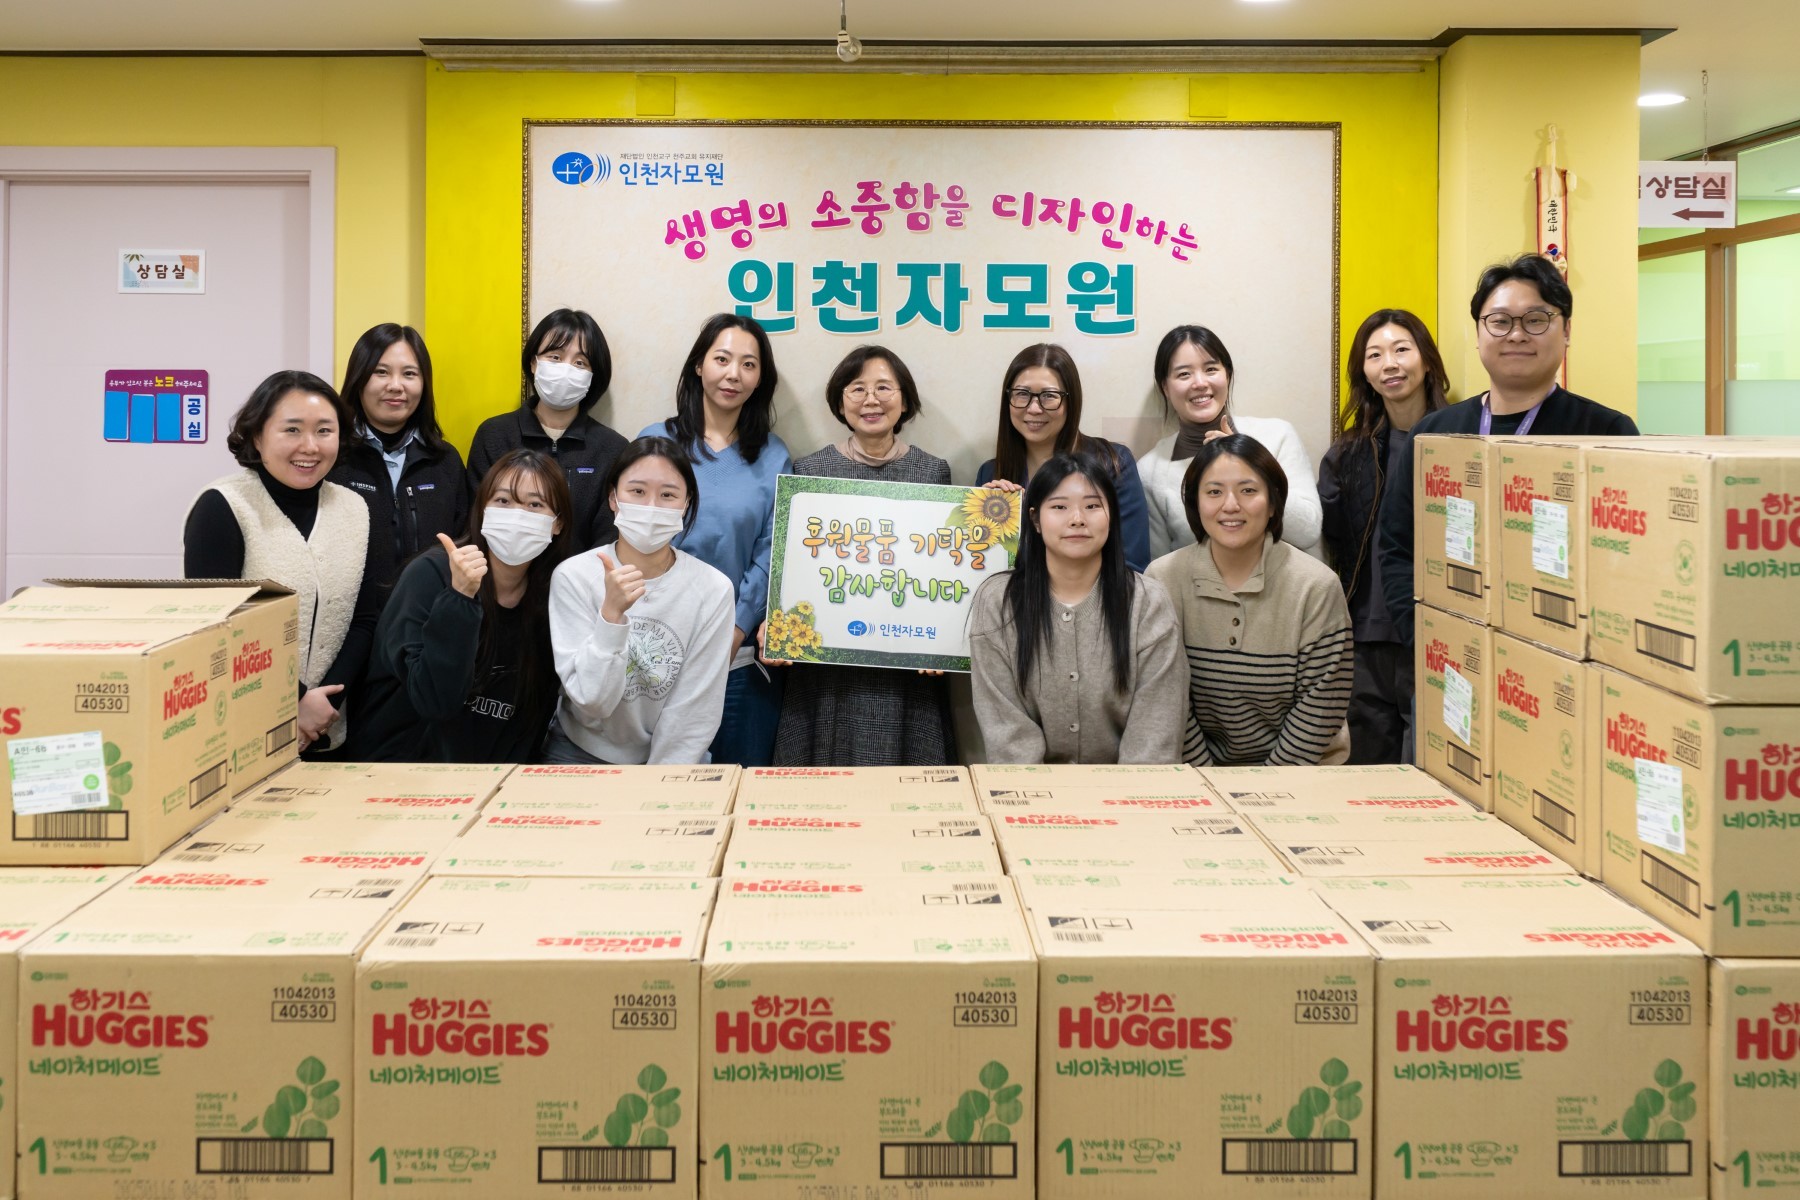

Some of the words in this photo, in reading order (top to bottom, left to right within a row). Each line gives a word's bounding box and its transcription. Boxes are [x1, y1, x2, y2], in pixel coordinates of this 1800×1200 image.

[619, 162, 723, 186] 인천자모원
[1646, 175, 1726, 199] 상담실
[664, 199, 788, 260] 생명의
[811, 180, 970, 236] 소중함을
[992, 191, 1198, 262] 디자인하는
[137, 264, 186, 280] 상담실
[728, 259, 1136, 336] 인천자모원
[154, 376, 174, 387] 노크
[175, 380, 203, 388] 해주세요
[1602, 486, 1628, 504] 하기스
[1591, 497, 1647, 536] HUGGIES
[802, 516, 898, 565] 후원물품
[910, 525, 990, 570] 기탁을
[819, 565, 969, 608] 감사합니다
[879, 624, 937, 639] 인천자모원
[232, 648, 273, 684] HUGGIES
[1722, 639, 1740, 677] 1
[76, 683, 129, 694] 11042013
[1497, 674, 1540, 719] HUGGIES
[82, 698, 123, 710] 40530
[163, 680, 208, 721] HUGGIES
[1619, 712, 1647, 737] 하기스
[488, 816, 603, 826] HUGGIES
[1005, 816, 1119, 826] HUGGIES
[299, 855, 425, 866] HUGGIES
[1424, 855, 1553, 865] HUGGIES
[135, 874, 269, 887] HUGGIES
[732, 882, 864, 893] HUGGIES
[1722, 890, 1740, 928] 1
[536, 936, 682, 948] HUGGIES
[1200, 933, 1348, 945] HUGGIES
[1523, 933, 1676, 945] HUGGIES
[69, 988, 151, 1011] 하기스
[273, 987, 336, 1000] 11042013
[614, 995, 676, 1007] 11042013
[955, 991, 1017, 1004] 11042013
[1094, 991, 1175, 1014] 하기스
[1296, 989, 1358, 1002] 11042013
[1630, 990, 1691, 1003] 11042013
[279, 1003, 329, 1019] 40530
[409, 998, 491, 1020] 하기스
[752, 995, 833, 1017] 하기스
[961, 1008, 1010, 1023] 40530
[1302, 1005, 1351, 1021] 40530
[1432, 994, 1511, 1017] 하기스
[1636, 1007, 1684, 1022] 40530
[31, 1003, 209, 1049] HUGGIES
[620, 1010, 669, 1026] 40530
[1058, 1006, 1233, 1050] HUGGIES
[372, 1012, 549, 1056] HUGGIES
[715, 1011, 892, 1054] HUGGIES
[1396, 1009, 1569, 1052] HUGGIES
[1737, 1017, 1800, 1060] HU
[29, 1056, 160, 1076] 네이처메이드
[370, 1064, 501, 1085] 네이처메이드
[713, 1062, 844, 1082] 네이처메이드
[1056, 1057, 1186, 1077] 네이처메이드
[1394, 1060, 1523, 1081] 네이처메이드
[29, 1137, 46, 1175] 1
[370, 1147, 387, 1185] 1
[714, 1144, 732, 1181] 1
[1056, 1138, 1074, 1175] 1
[1394, 1142, 1412, 1180] 1
[1733, 1150, 1750, 1188] 1
